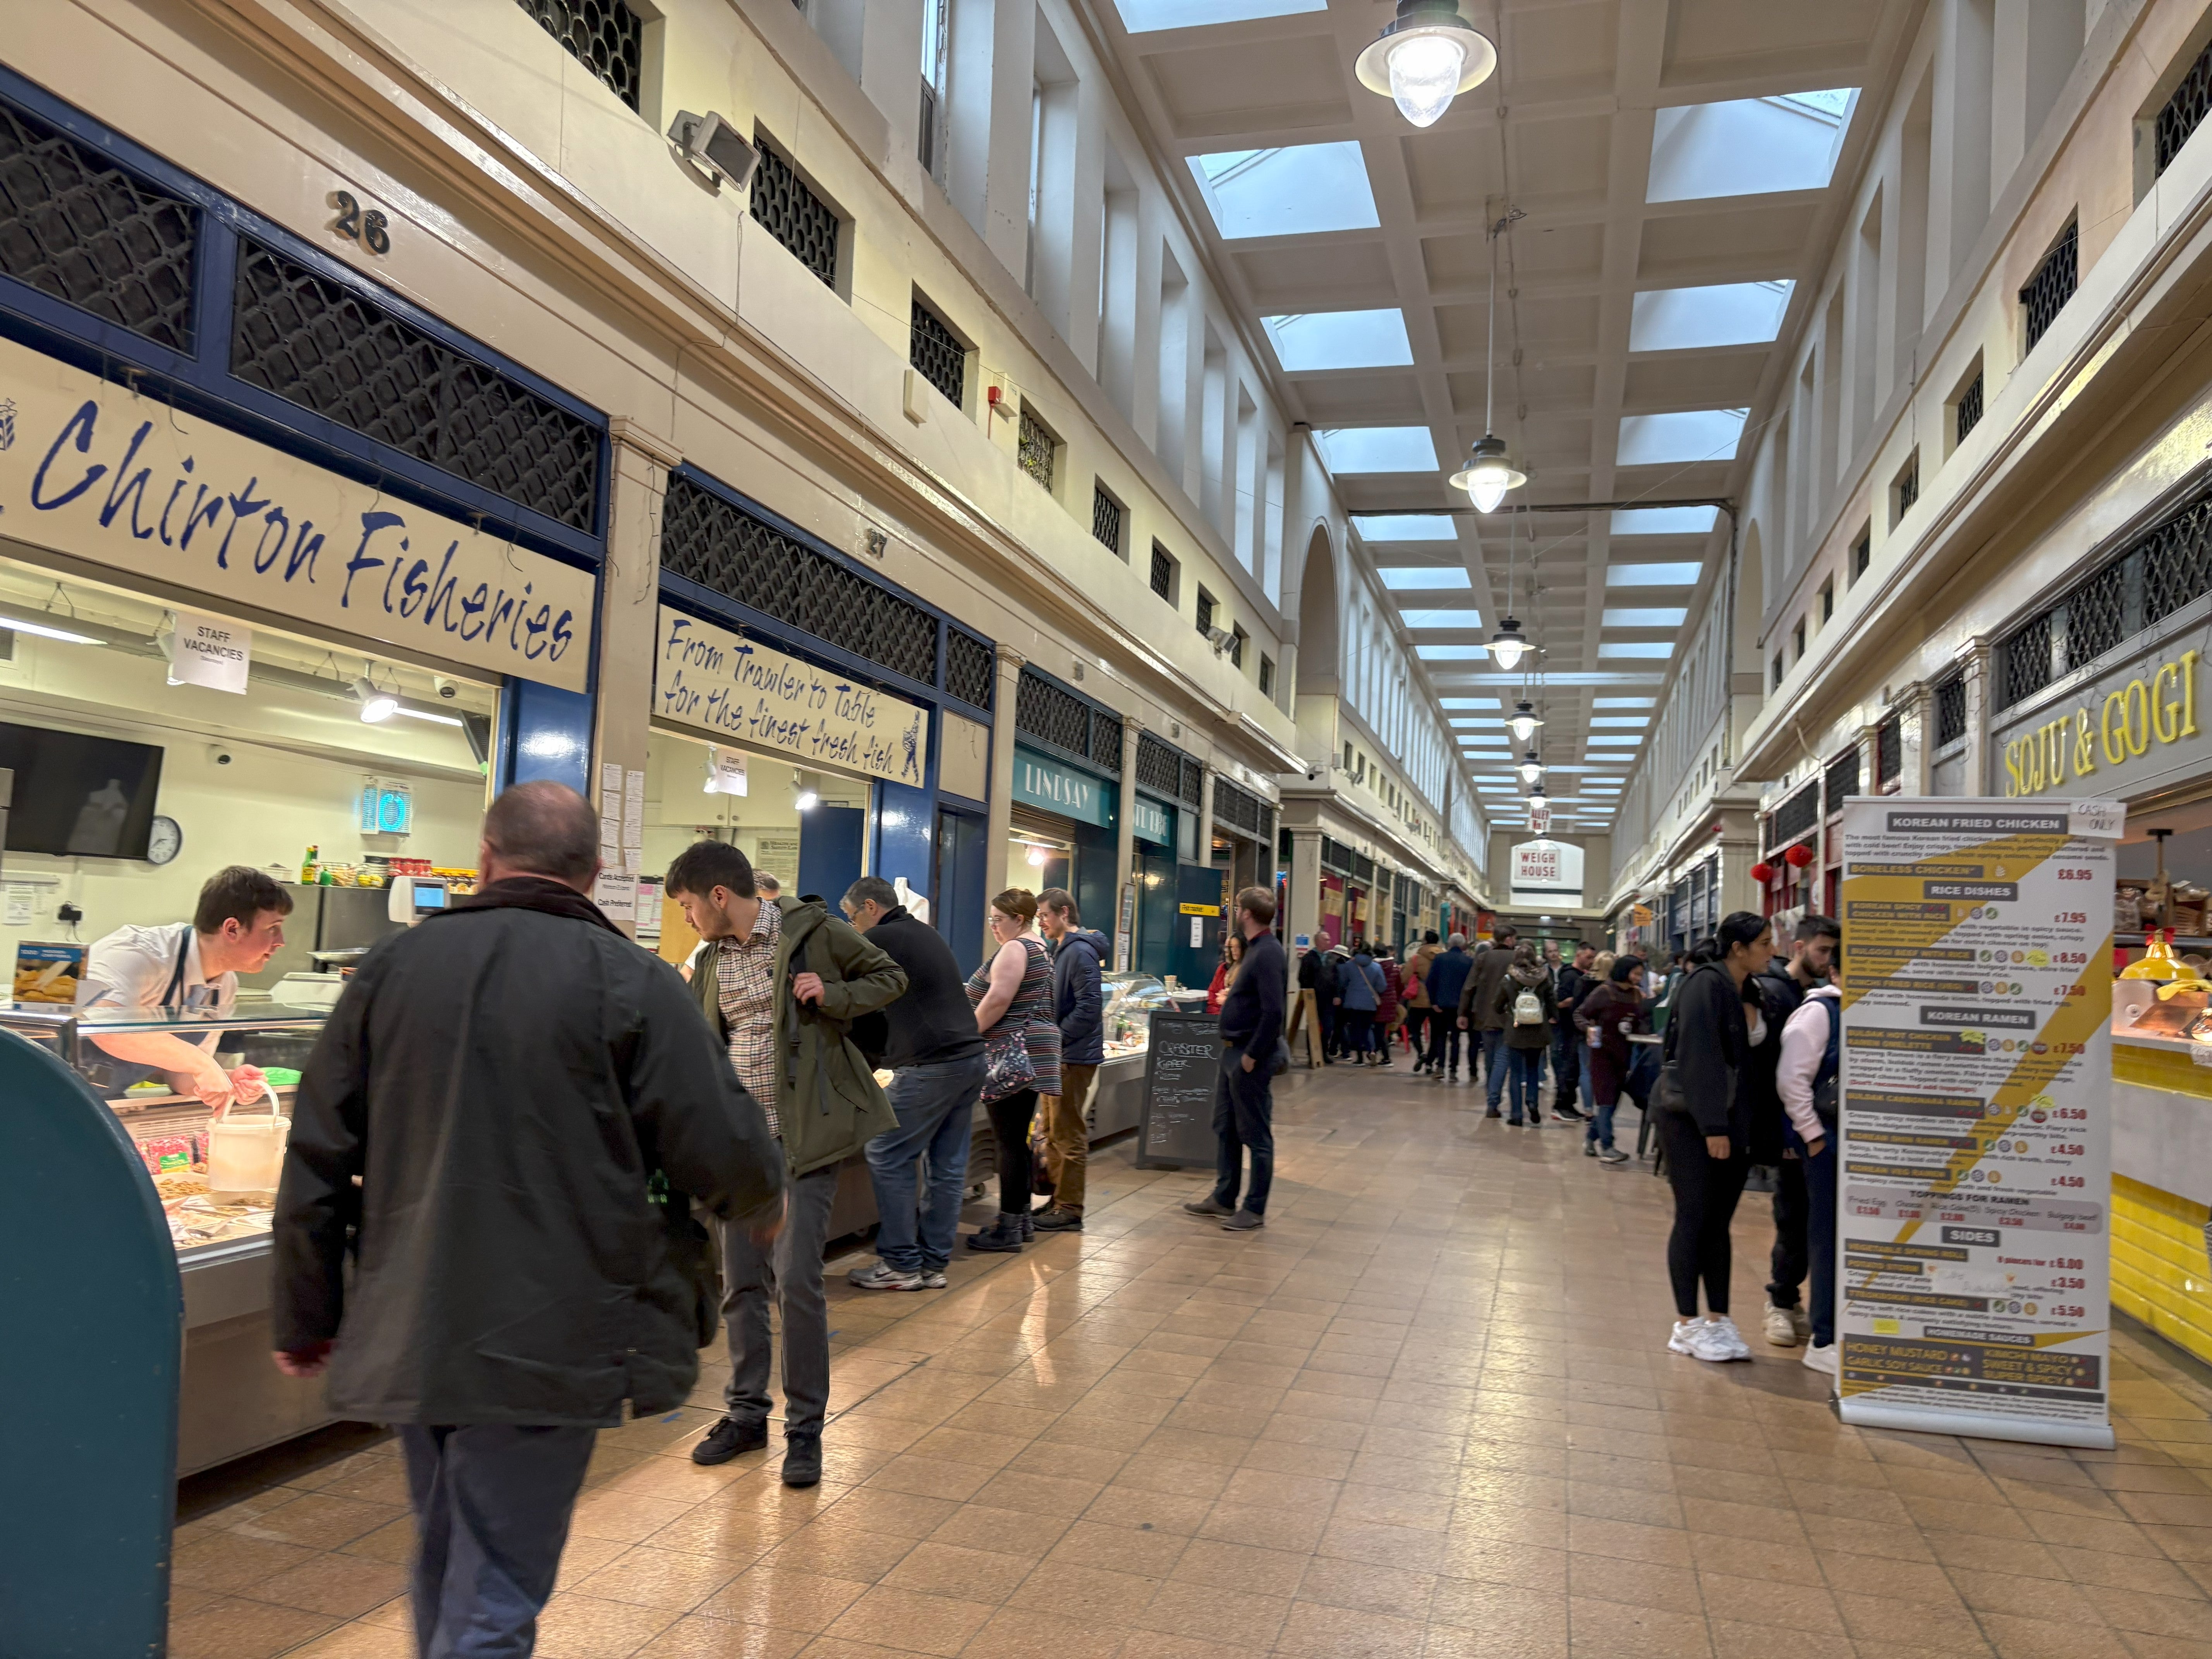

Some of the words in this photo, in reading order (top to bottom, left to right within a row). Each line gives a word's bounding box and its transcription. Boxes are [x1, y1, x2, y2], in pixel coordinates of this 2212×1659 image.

[325, 190, 390, 256] 26
[31, 400, 325, 584] Chirton
[342, 511, 573, 663] Fisheries
[198, 626, 231, 642] STAFF
[184, 637, 244, 661] VACANCIES
[667, 620, 724, 671] From
[733, 645, 804, 702] Trawler
[809, 678, 828, 710] to
[835, 684, 876, 729] Table
[665, 670, 699, 715] for
[707, 688, 742, 732] the
[749, 698, 810, 747] finest
[811, 724, 858, 766] fresh
[863, 735, 894, 775] fish
[2005, 716, 2069, 798] SOJU
[2074, 708, 2095, 775] &
[2102, 649, 2199, 765] GOGI
[1025, 763, 1091, 811] LINDSAY
[1892, 817, 1949, 828] KOREAN
[1952, 818, 1992, 828] FRIED
[1996, 819, 2060, 830] CHICKEN
[1520, 852, 1556, 864] WEIGH
[1521, 865, 1556, 877] HOUSE
[1930, 885, 1961, 895] RICE
[1964, 886, 2012, 897] DISHES
[2054, 910, 2087, 924] £7.95
[2052, 951, 2088, 965] £8.50
[1927, 1011, 1980, 1022] KOREAN
[1982, 1013, 2029, 1024] RAMEN
[2052, 1042, 2086, 1054] £7.50
[2052, 1107, 2087, 1121] £6.50
[2051, 1142, 2085, 1156] £4.50
[2051, 1175, 2085, 1188] £4.50
[1909, 1190, 1964, 1200] TOPPINGS
[1965, 1194, 1988, 1202] FOR
[1990, 1195, 2030, 1205] RAMEN
[1950, 1230, 1996, 1242] SIDES
[2049, 1257, 2085, 1270] £6.00
[1846, 1342, 1888, 1355] HONEY
[1889, 1345, 1949, 1362] MUSTARD
[1885, 1359, 1908, 1371] SOY
[1909, 1362, 1944, 1374] SAUCE
[1982, 1359, 2024, 1372] SWEET
[2035, 1363, 2075, 1376] SPICY
[1982, 1370, 2026, 1382] SUPER
